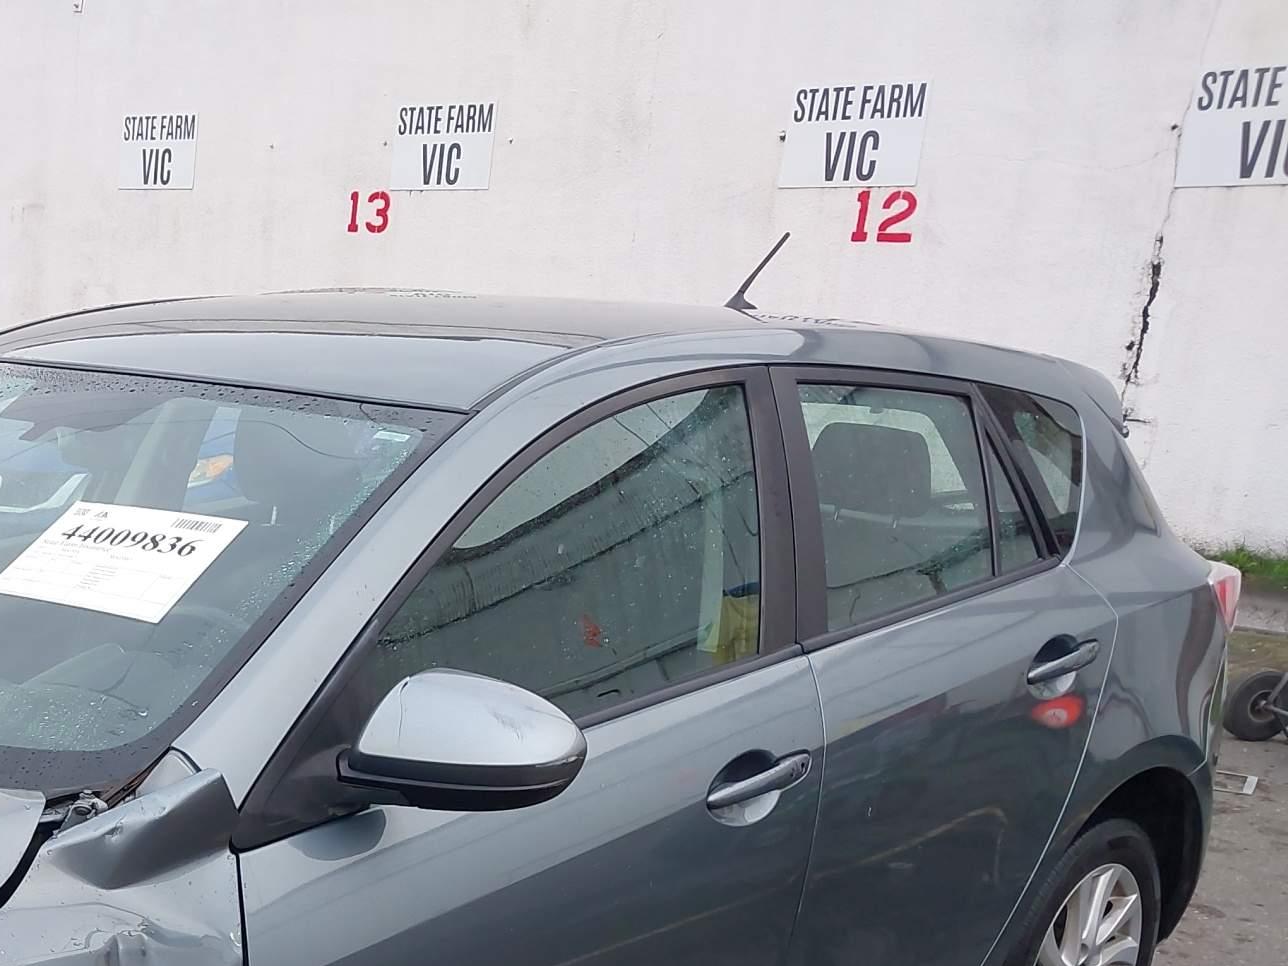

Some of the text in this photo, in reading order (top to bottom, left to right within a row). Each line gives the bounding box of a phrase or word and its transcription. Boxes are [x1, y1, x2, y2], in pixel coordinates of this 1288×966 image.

[793, 83, 927, 122] STATE FARM
[1197, 66, 1287, 111] STATE
[124, 114, 195, 141] STATE FARM
[398, 103, 494, 135] STATE FARM
[142, 148, 172, 185] VIC
[422, 142, 462, 185] VIC
[824, 130, 880, 181] VIC
[1239, 119, 1288, 179] VI
[347, 191, 391, 233] 13
[850, 190, 918, 242] 12
[61, 524, 206, 557] 44009836
